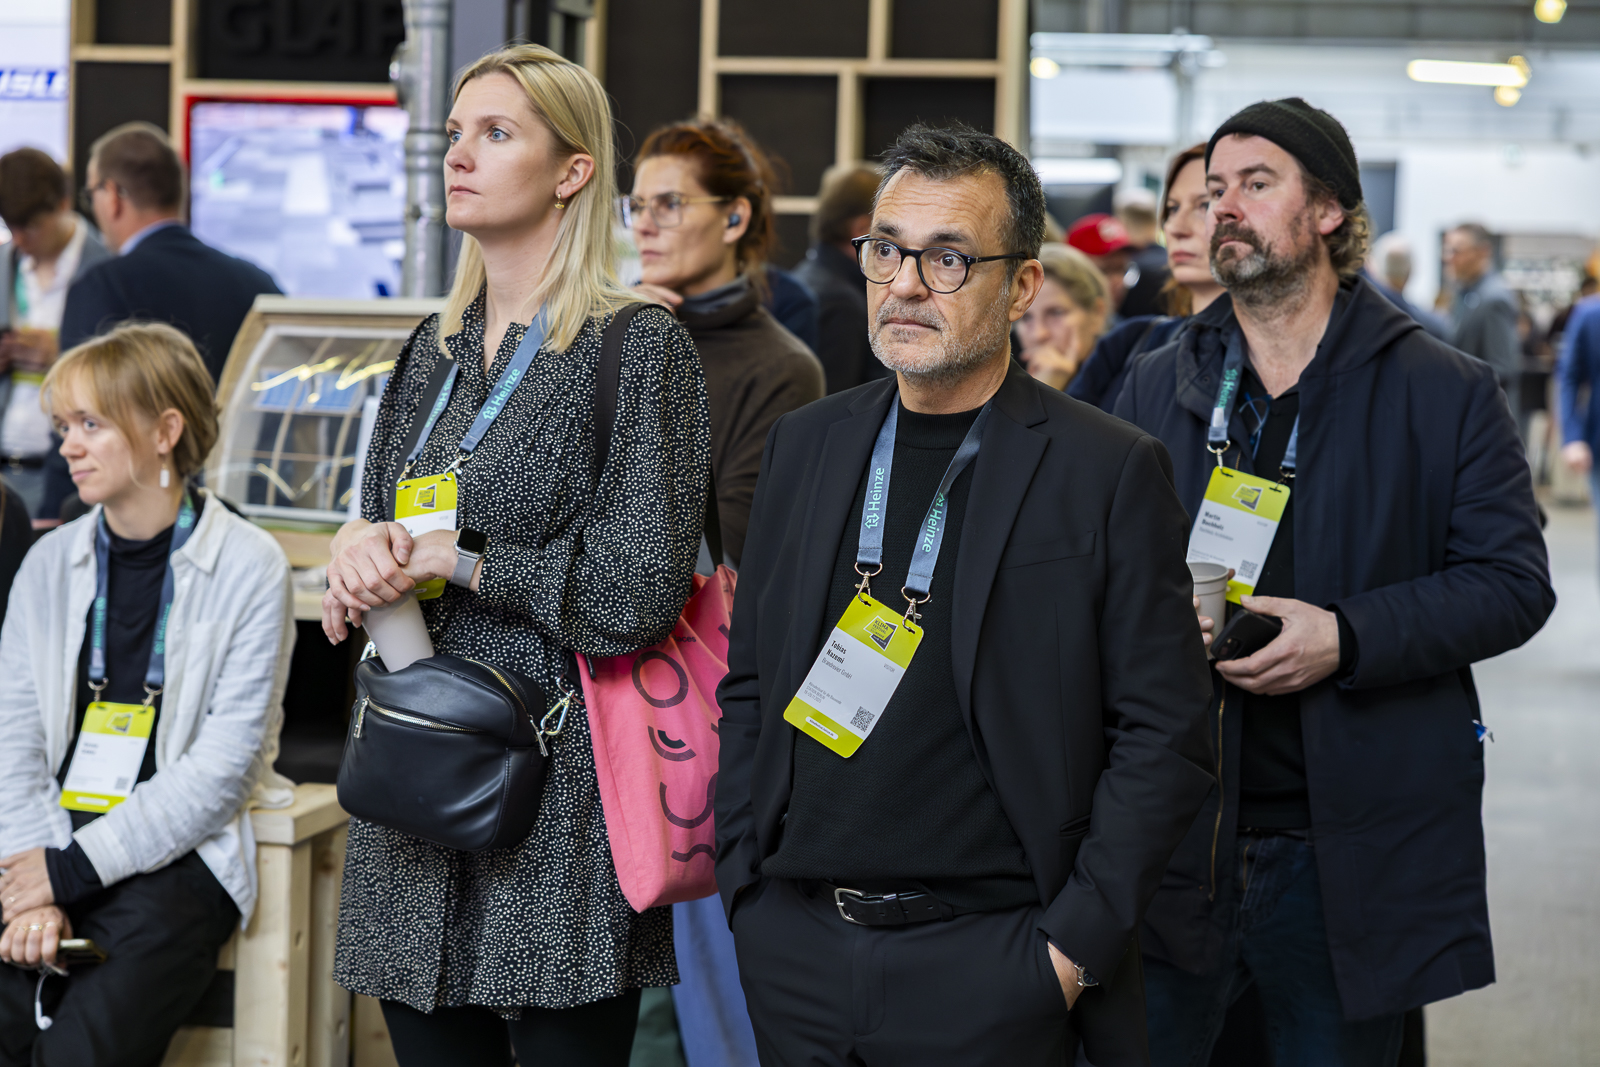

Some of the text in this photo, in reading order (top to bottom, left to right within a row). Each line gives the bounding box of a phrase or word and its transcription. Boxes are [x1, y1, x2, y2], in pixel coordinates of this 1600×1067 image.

[491, 368, 521, 407] Heinze
[425, 392, 448, 428] Heinze
[868, 467, 884, 510] Heinze
[1204, 511, 1221, 521] Martin
[922, 508, 943, 553] Heinze
[874, 620, 888, 631] KLIMA
[831, 640, 847, 655] Tobias
[826, 649, 846, 664] Nazemi
[840, 669, 853, 680] GmbH
